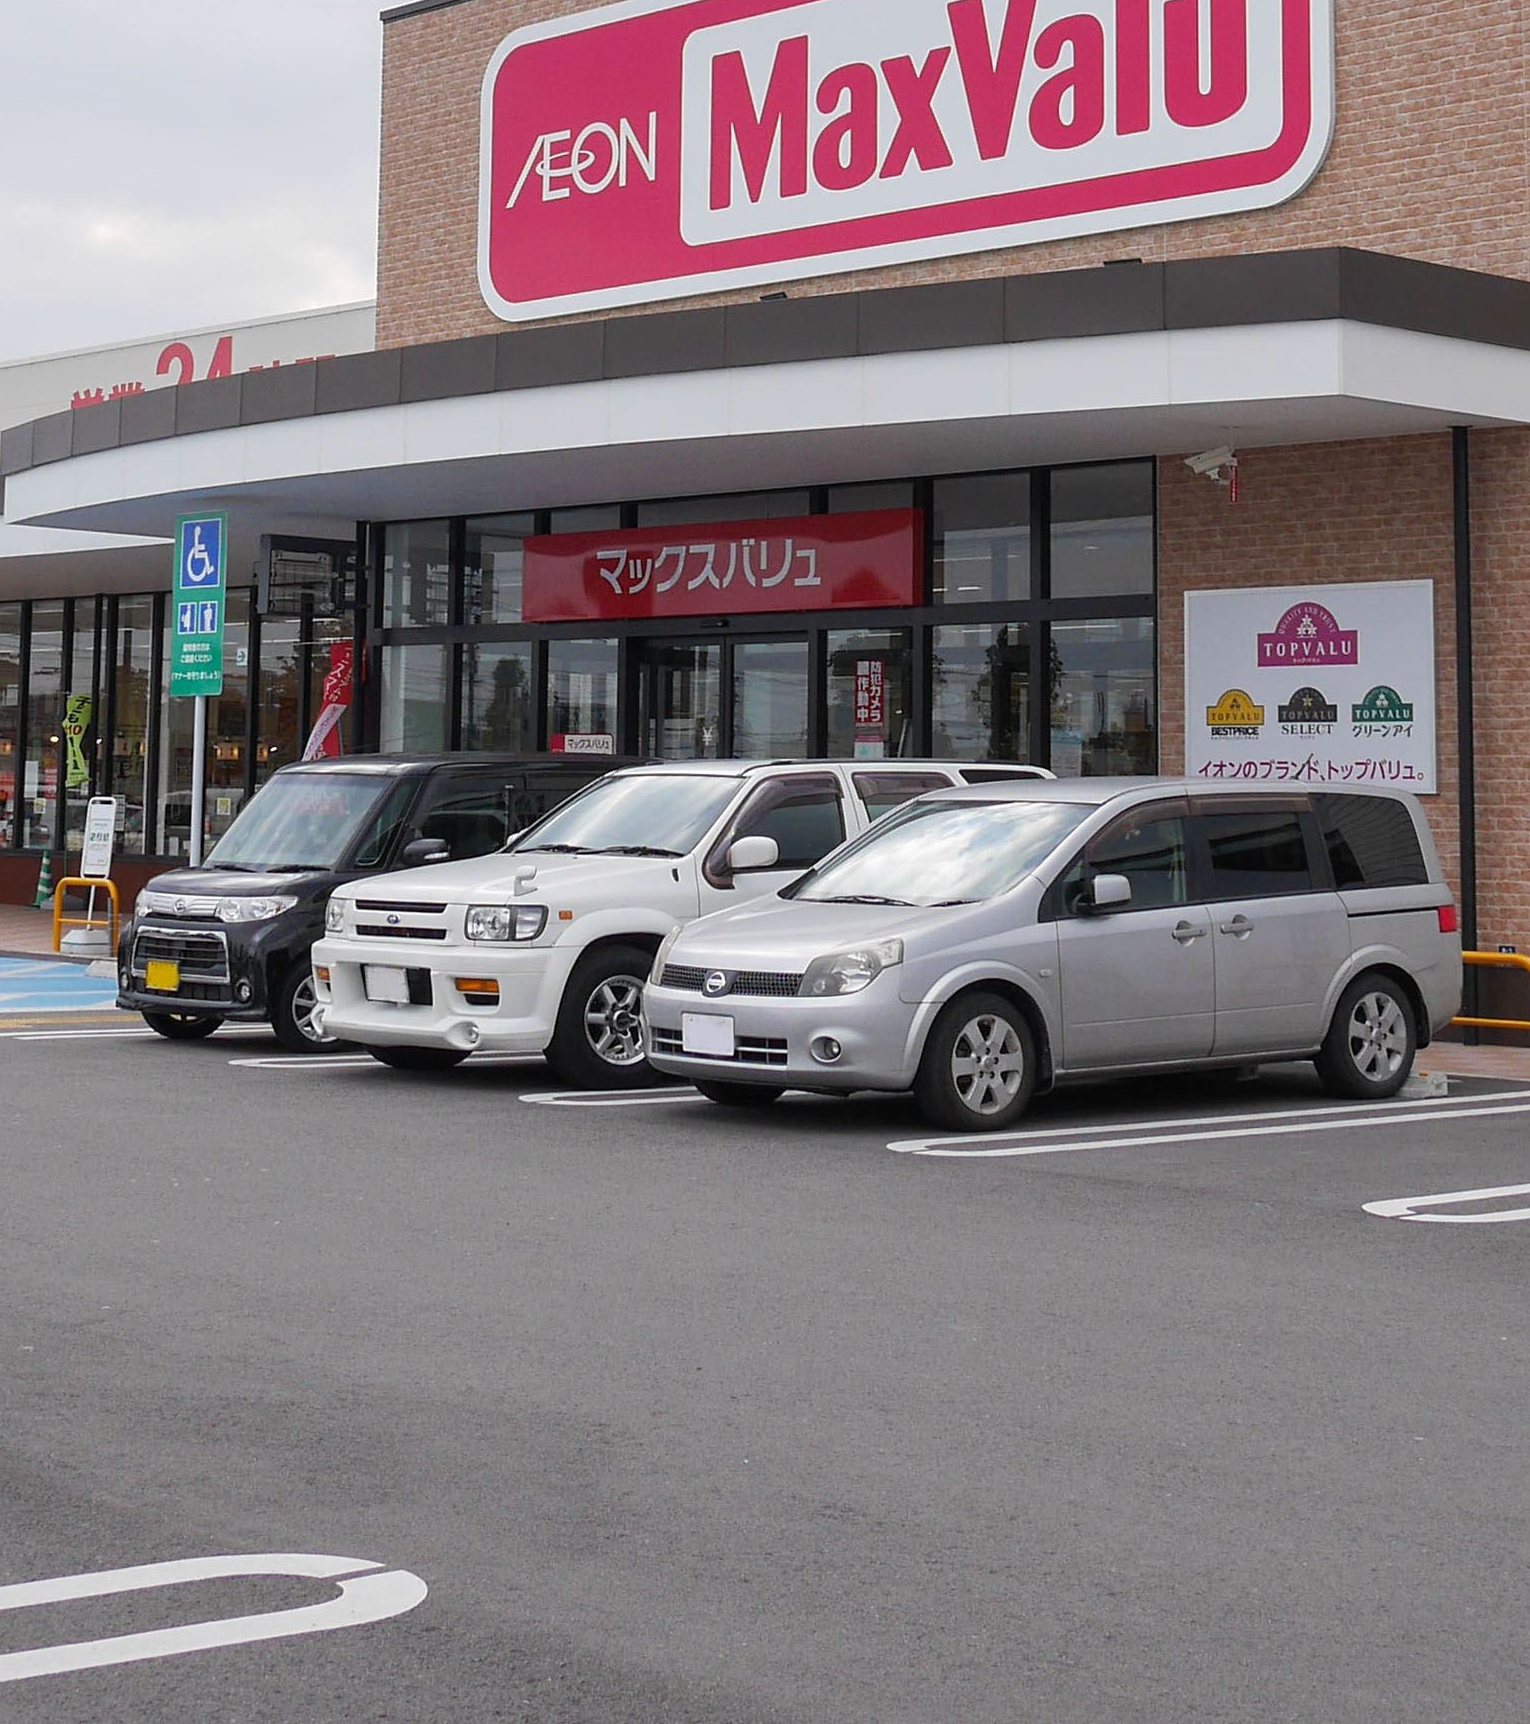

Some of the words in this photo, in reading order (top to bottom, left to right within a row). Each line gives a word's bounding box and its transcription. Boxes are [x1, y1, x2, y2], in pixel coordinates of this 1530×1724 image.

[597, 539, 821, 594] マックスバリュ
[1264, 641, 1351, 657] TOPVALU
[870, 660, 882, 722] 防犯カメラ
[1355, 708, 1410, 719] TOPVALU
[1281, 724, 1334, 735] SELECT
[1352, 724, 1413, 738] グリーンアイ
